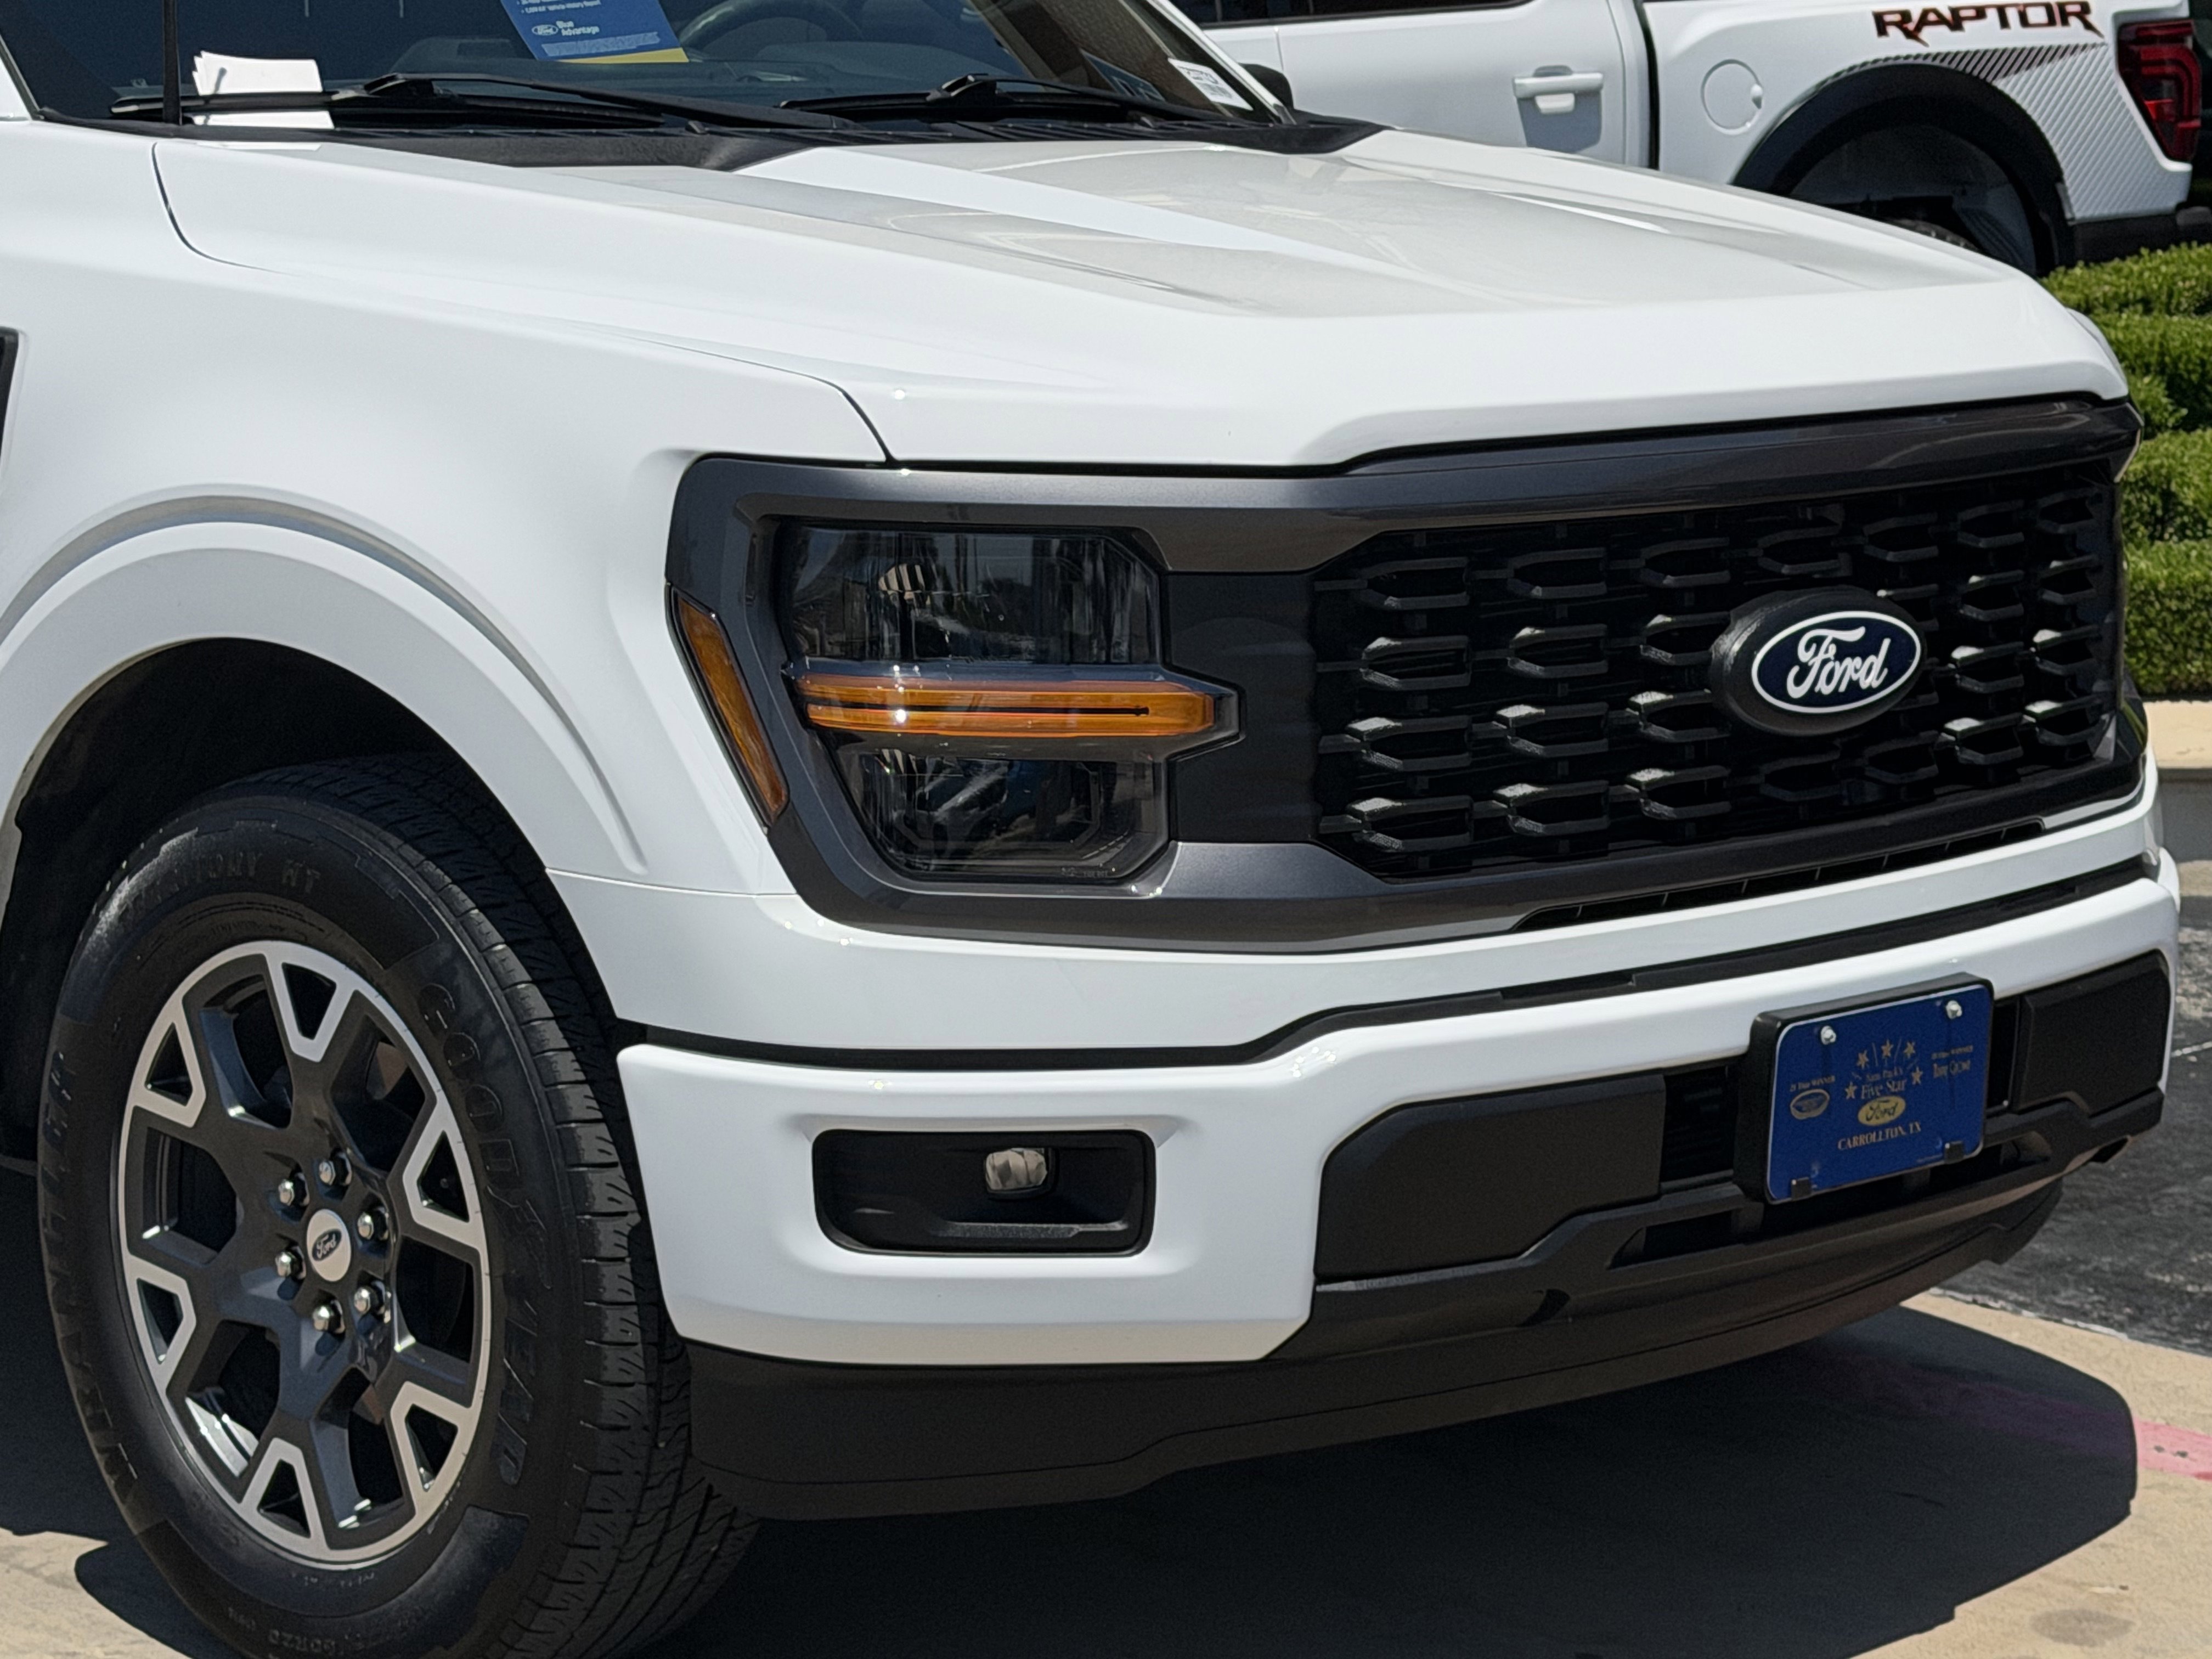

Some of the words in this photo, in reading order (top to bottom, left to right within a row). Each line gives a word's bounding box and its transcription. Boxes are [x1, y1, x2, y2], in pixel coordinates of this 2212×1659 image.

[1872, 1, 2104, 48] RAPTOR
[1786, 625, 1892, 699] Ford
[1861, 1084, 1883, 1099] Five
[1886, 1078, 1908, 1092] Star
[1866, 1099, 1898, 1121] Ford
[1909, 1121, 1922, 1134] TX
[316, 1233, 337, 1259] Ford
